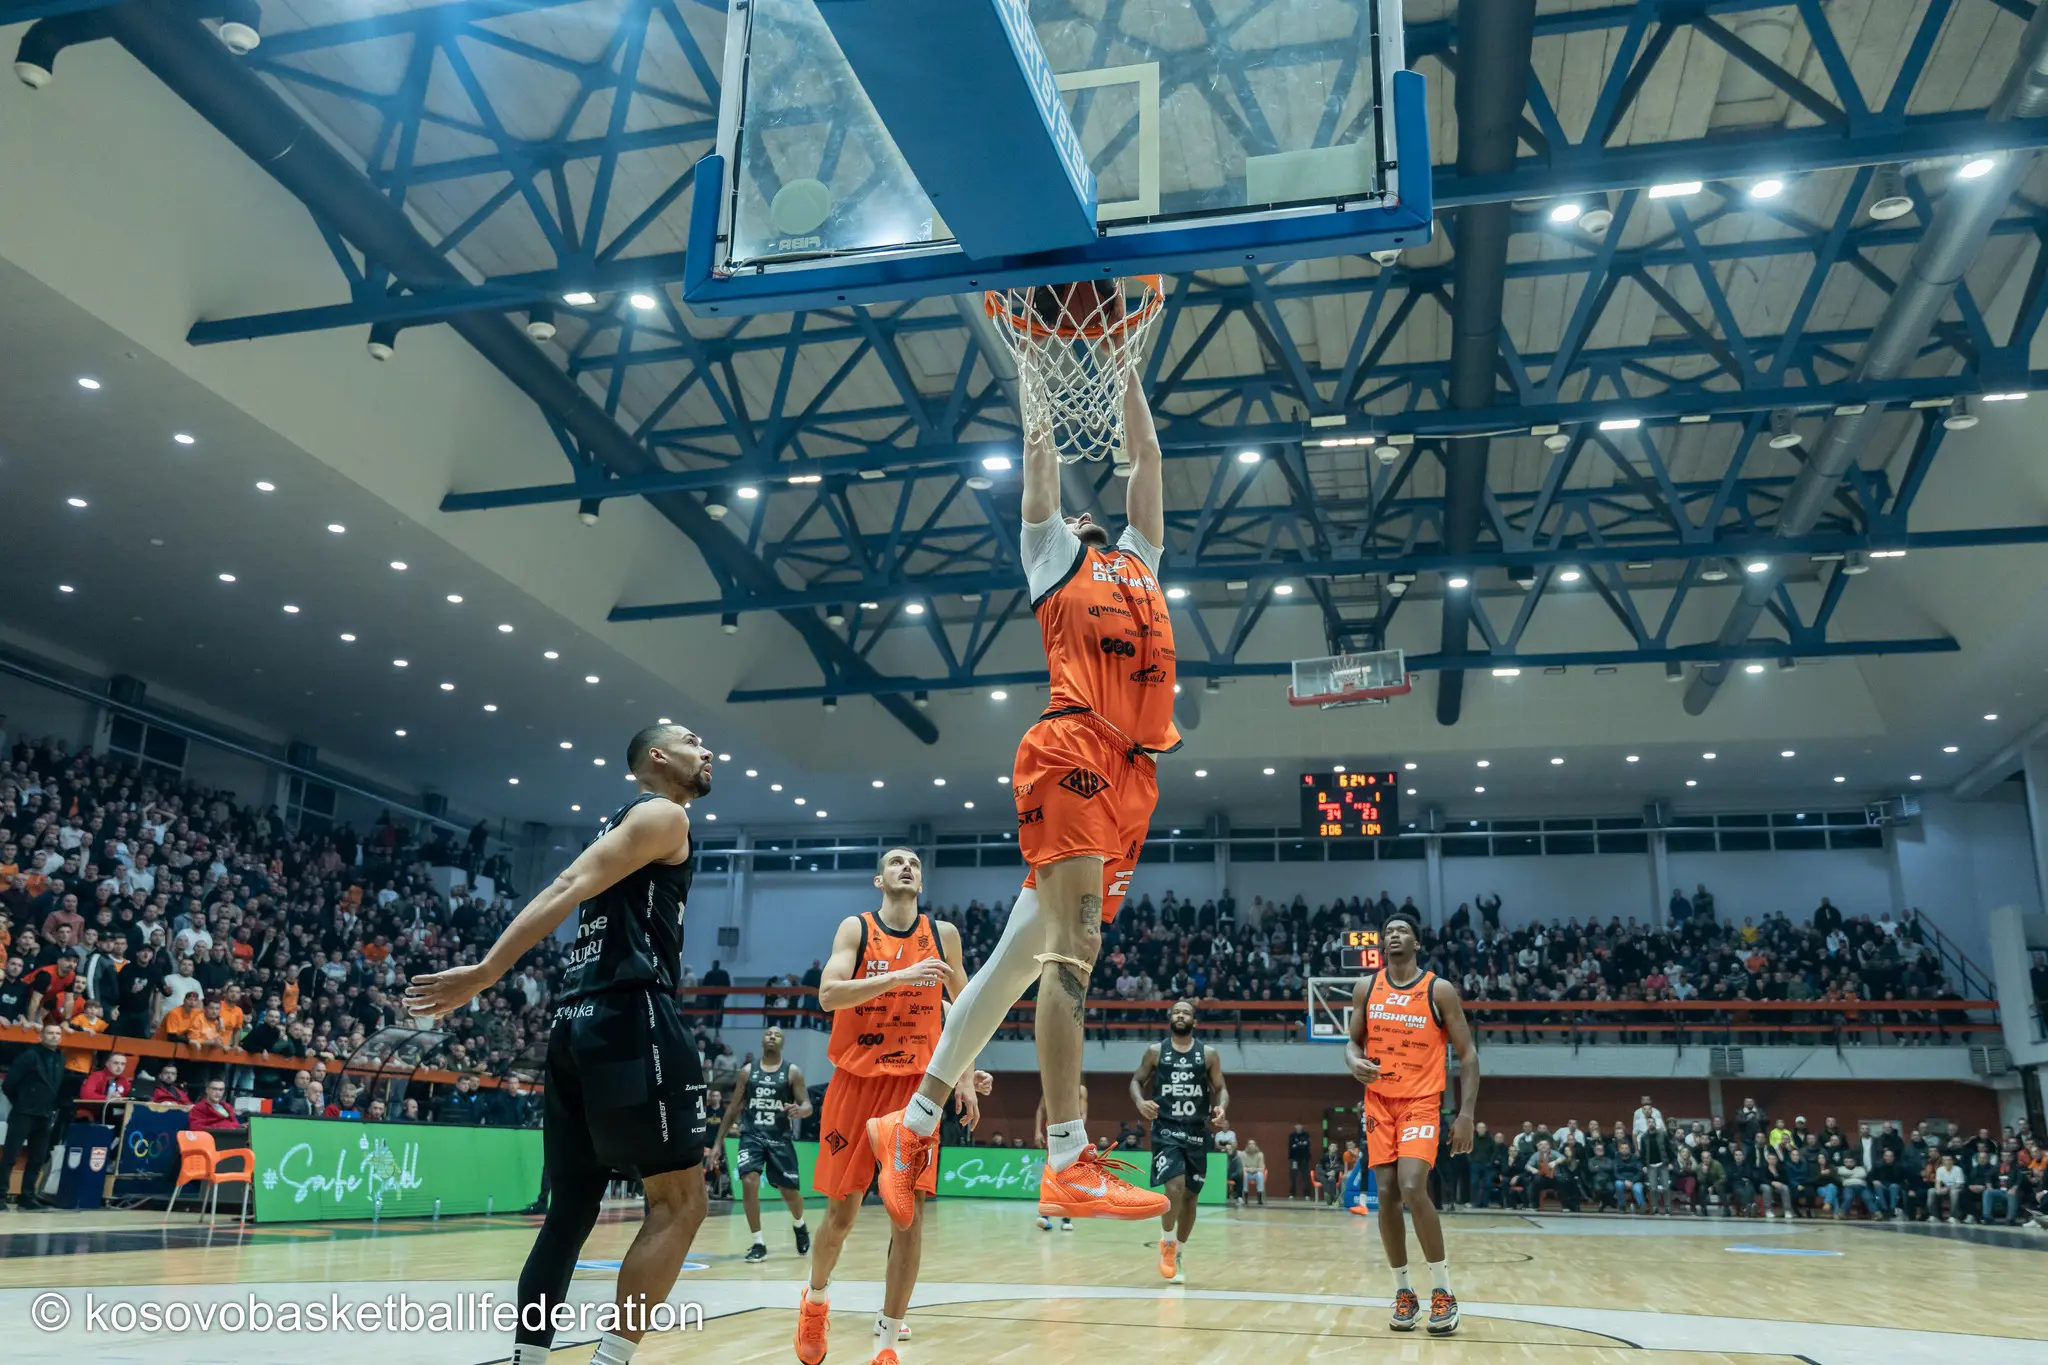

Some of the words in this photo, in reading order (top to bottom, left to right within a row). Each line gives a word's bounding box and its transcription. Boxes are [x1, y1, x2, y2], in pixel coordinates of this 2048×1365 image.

[1041, 67, 1090, 195] SYSTEM
[1361, 949, 1380, 968] 19
[1385, 992, 1411, 1007] 20
[652, 1043, 662, 1086] WILDWEST
[1161, 1084, 1203, 1097] PEJA
[749, 1099, 784, 1111] PEJA
[1171, 1100, 1197, 1117] 10
[659, 1100, 669, 1143] WILDWEST
[754, 1111, 776, 1126] 13
[1400, 1125, 1435, 1142] 20
